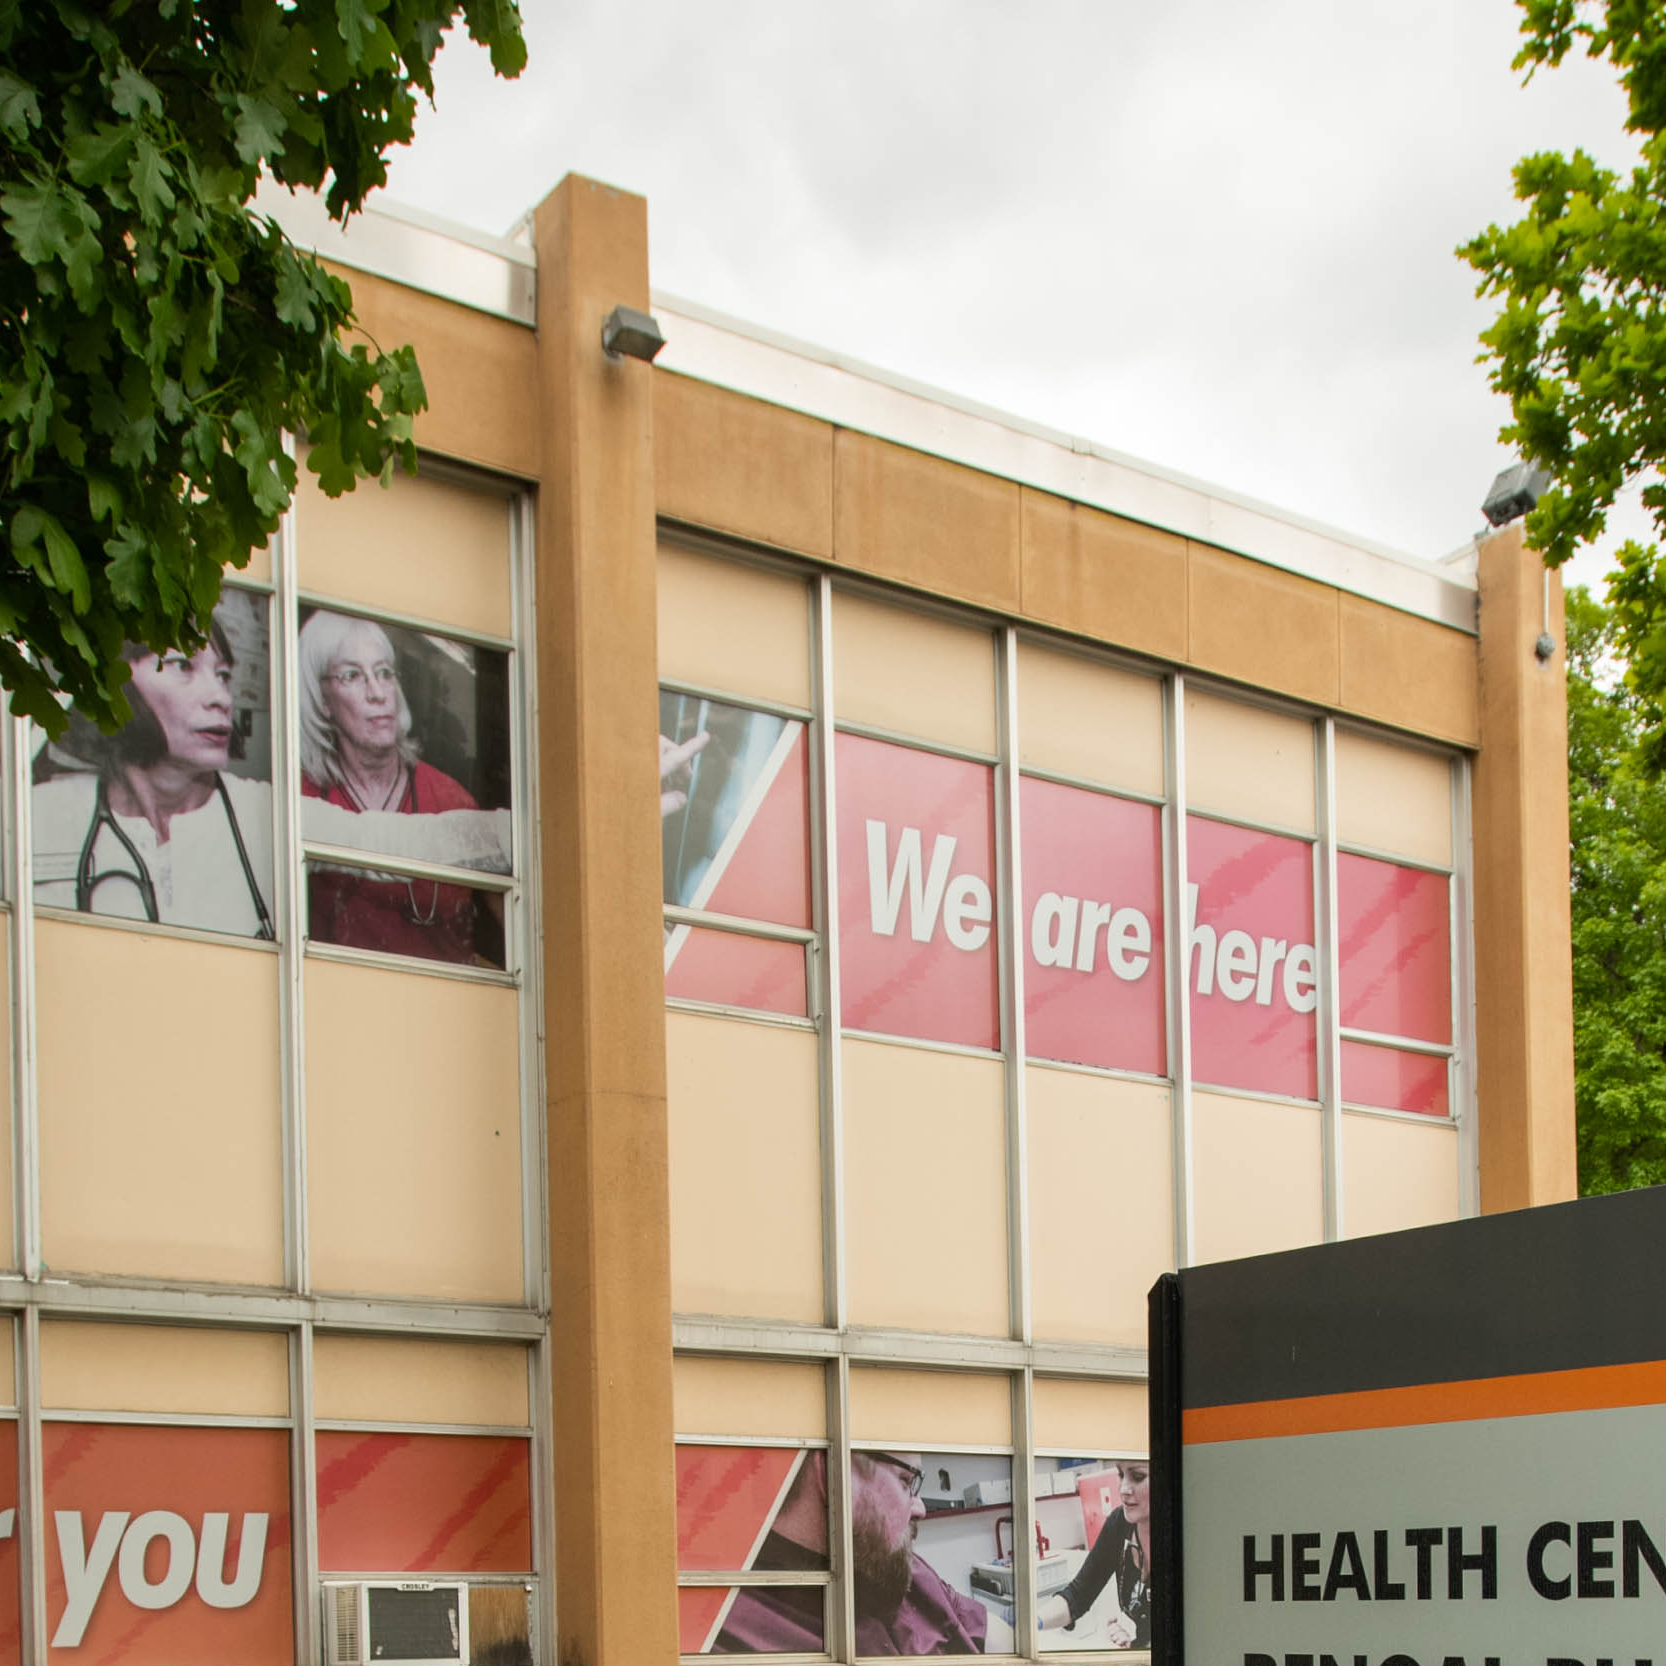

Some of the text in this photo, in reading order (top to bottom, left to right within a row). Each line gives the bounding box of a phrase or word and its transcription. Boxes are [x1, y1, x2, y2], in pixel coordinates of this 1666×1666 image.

[865, 819, 1317, 1013] We are here
[50, 1510, 269, 1648] you
[1243, 1525, 1498, 1602] HEALTH
